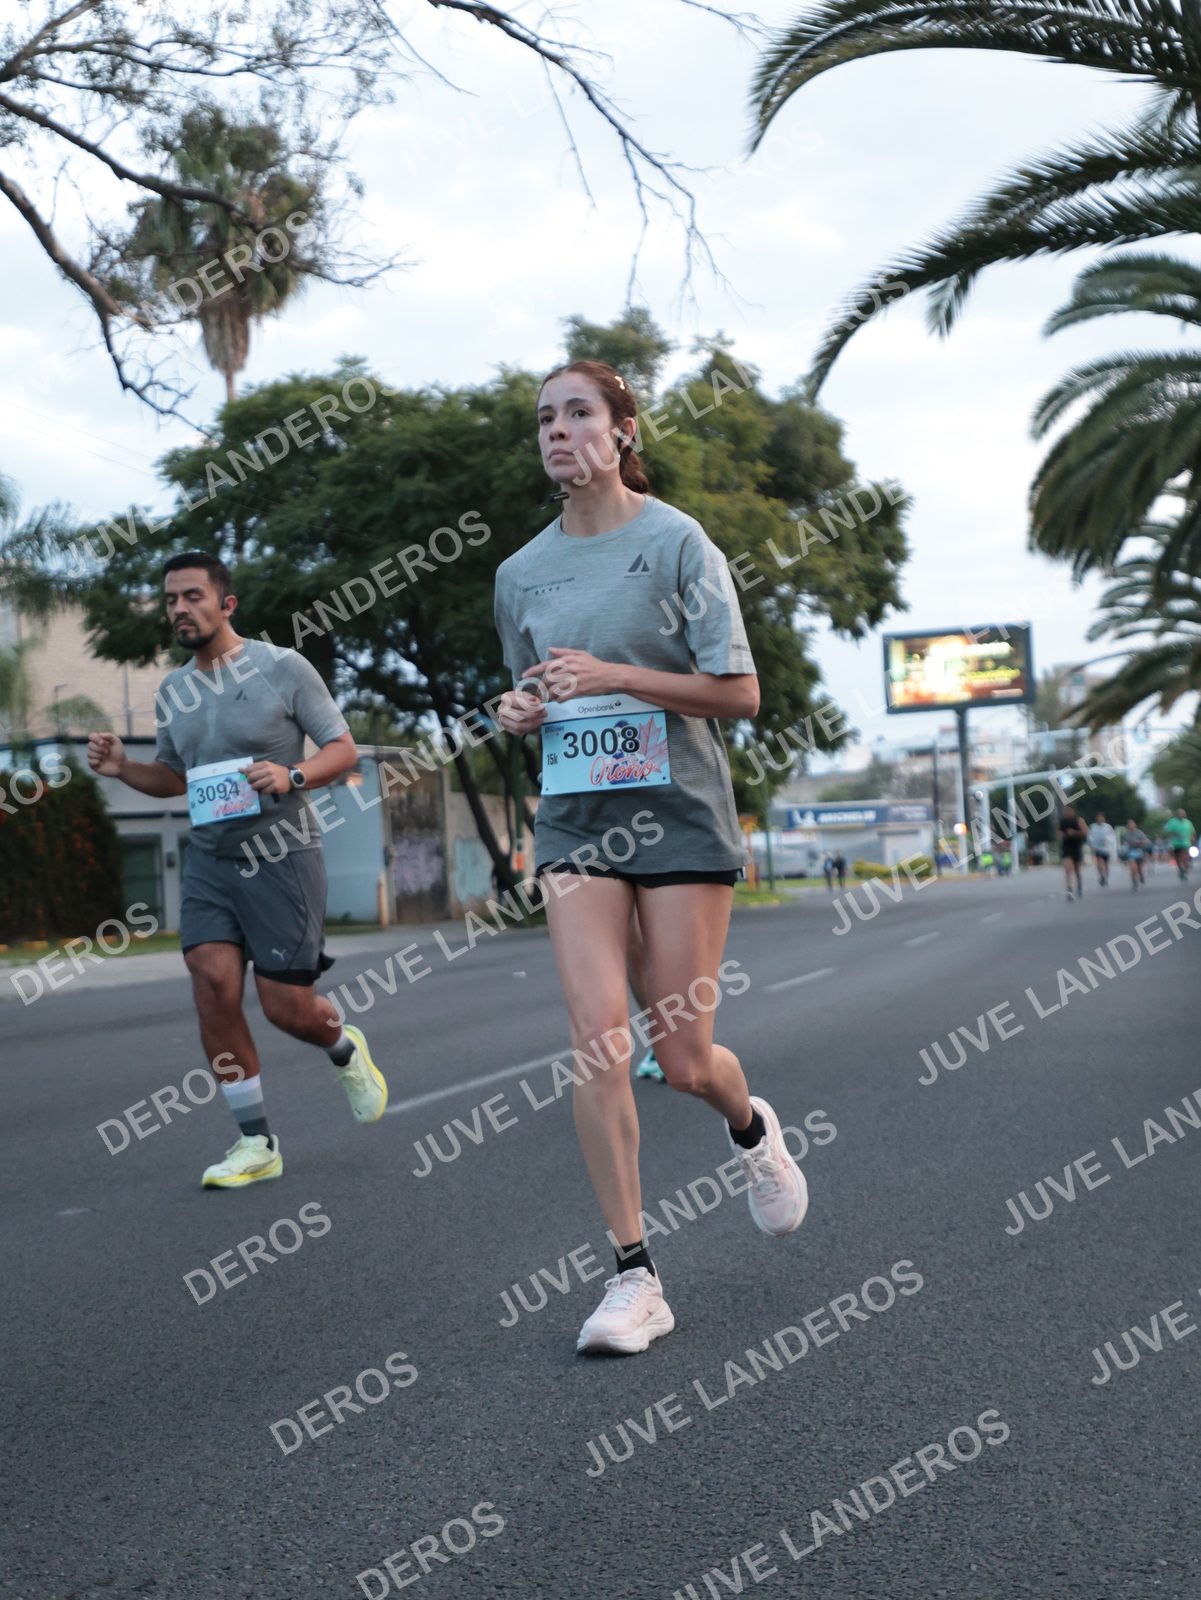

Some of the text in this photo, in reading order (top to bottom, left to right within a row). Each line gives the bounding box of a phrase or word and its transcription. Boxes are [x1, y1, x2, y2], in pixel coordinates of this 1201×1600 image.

[577, 702, 615, 714] Openbank
[562, 726, 641, 759] 3008
[196, 780, 240, 804] 3094
